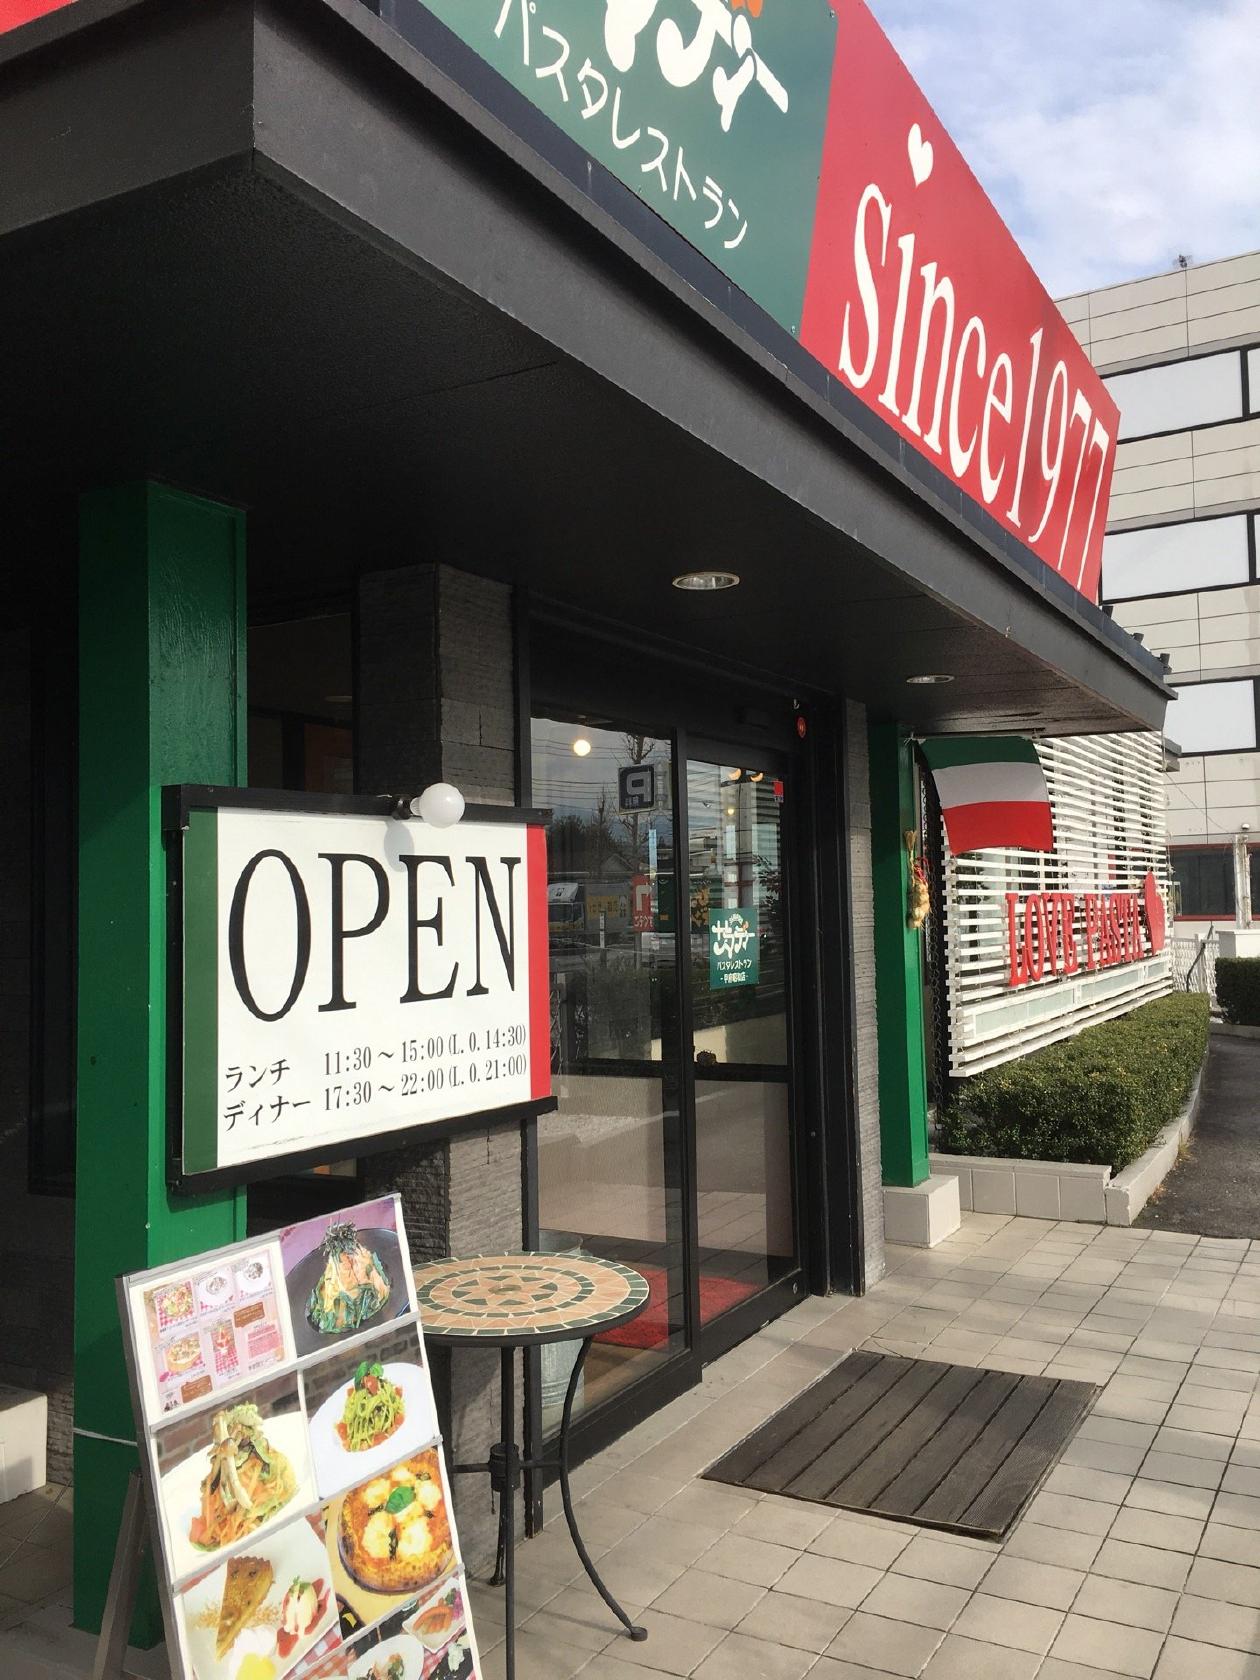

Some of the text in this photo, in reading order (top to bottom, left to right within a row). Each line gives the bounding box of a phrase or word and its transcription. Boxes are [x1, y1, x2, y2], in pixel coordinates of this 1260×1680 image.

[228, 849, 521, 1022] OPEN
[1005, 893, 1145, 987] LOVE PASTA
[225, 1059, 291, 1093] ランチ
[223, 1095, 312, 1132] ディナー
